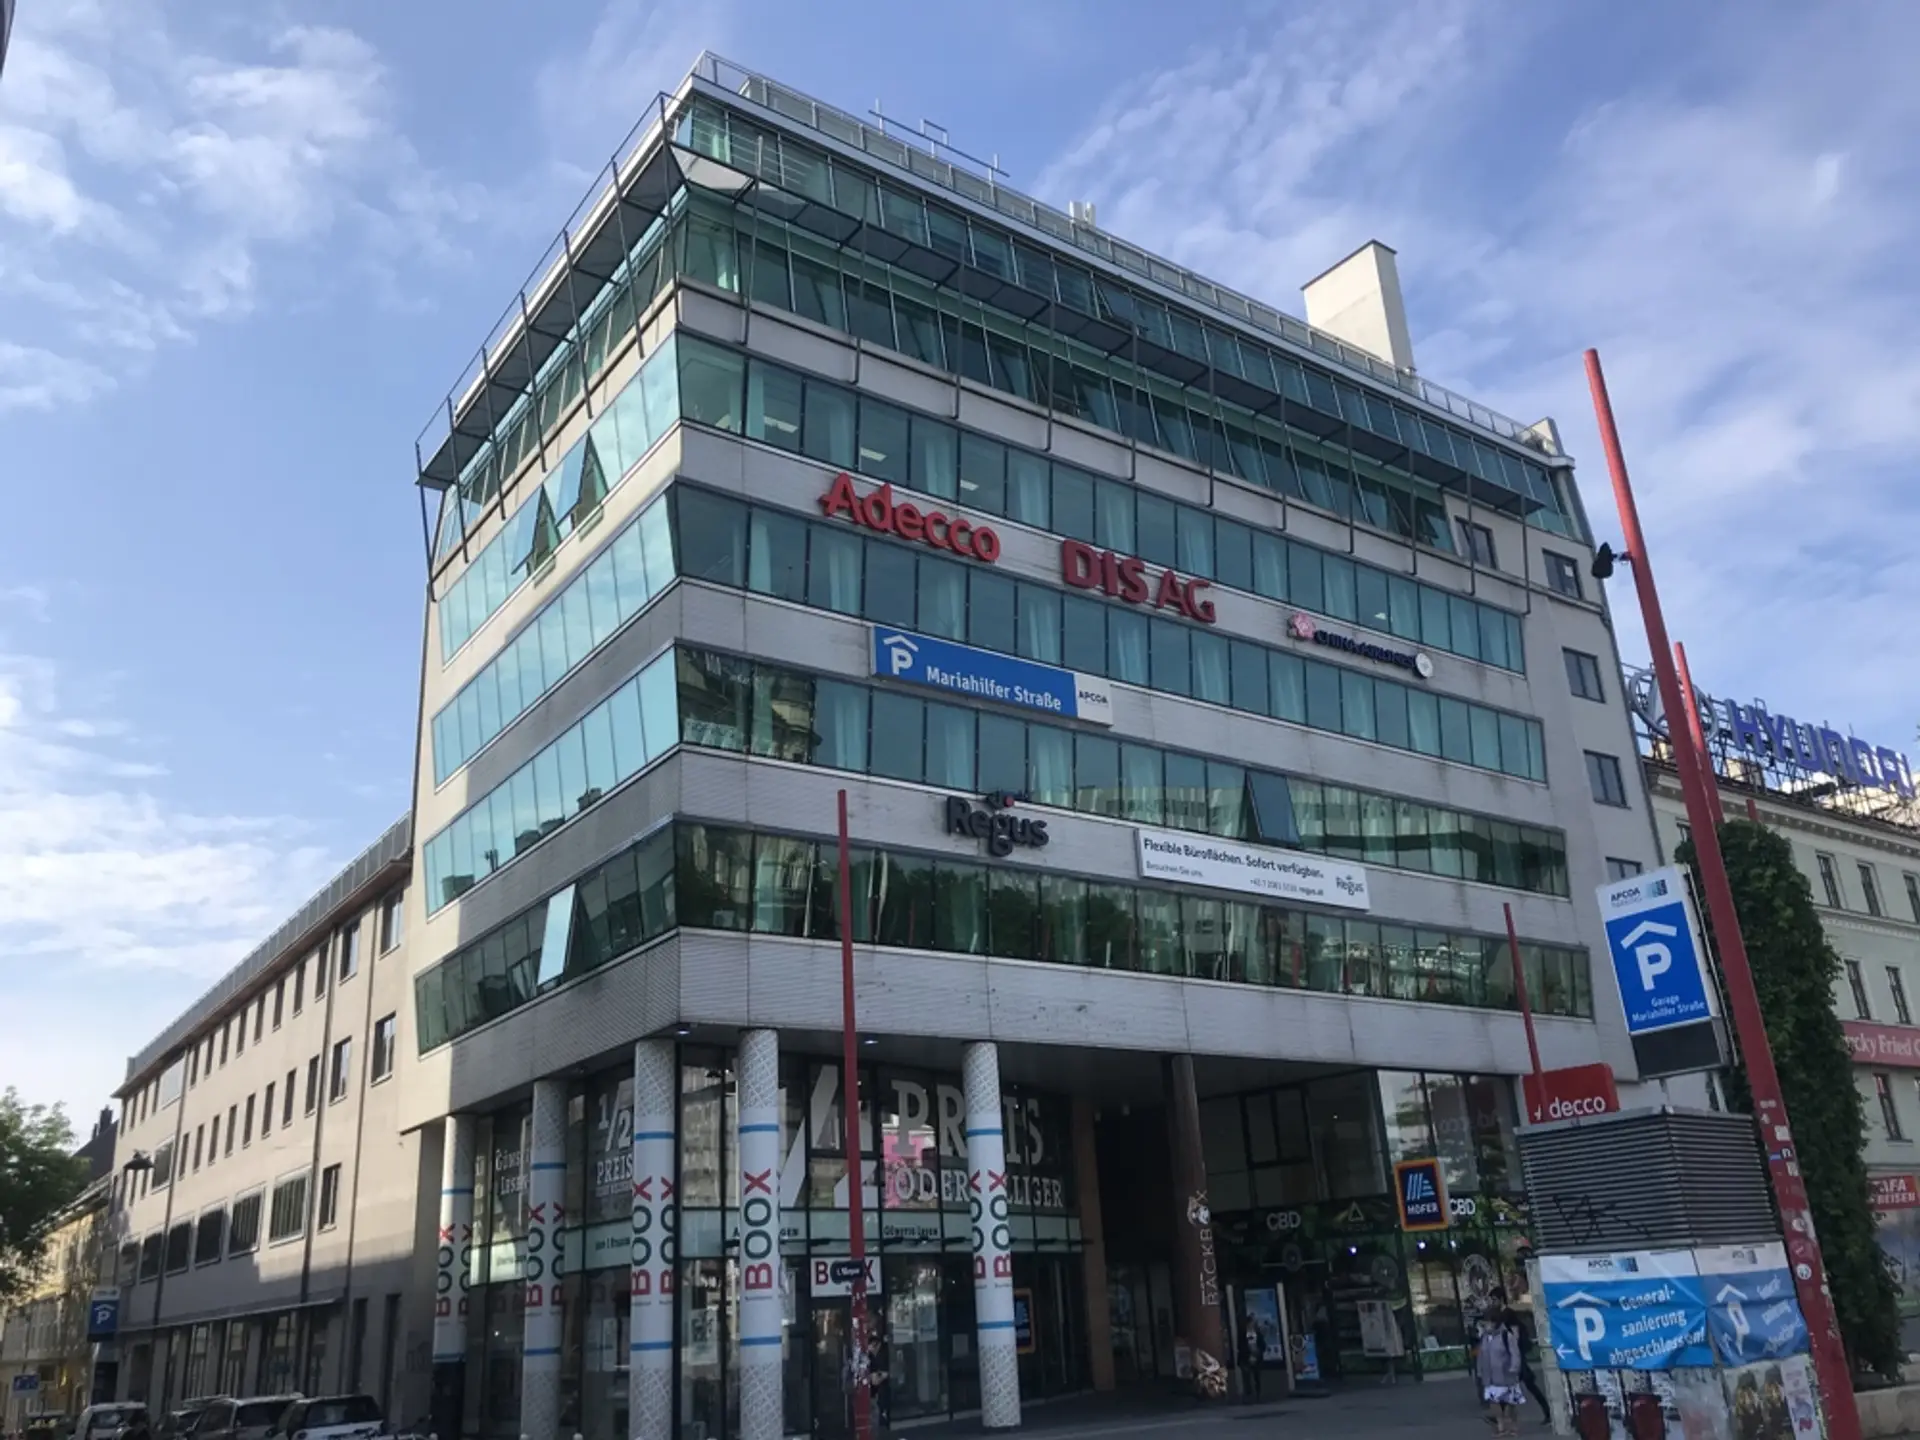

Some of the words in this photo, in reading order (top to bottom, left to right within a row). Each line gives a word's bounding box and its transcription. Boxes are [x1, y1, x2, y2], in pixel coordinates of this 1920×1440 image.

[819, 472, 1000, 562] Adecco
[1063, 540, 1149, 603] DIS
[1156, 570, 1216, 624] AG
[926, 665, 1010, 700] Mariahilfer
[1014, 686, 1062, 711] Straße
[1724, 698, 1916, 798] HYUNDAI
[947, 796, 1050, 857] Regus
[1144, 838, 1182, 856] Flexible
[1246, 854, 1277, 871] Sofort
[1336, 876, 1364, 896] Regus
[1611, 886, 1641, 902] APCOA
[1651, 994, 1680, 1008] Garage
[1877, 1034, 1912, 1057] Fried
[891, 1079, 1044, 1166] PRIS
[597, 1154, 633, 1185] PREIS
[896, 1167, 970, 1204] ODER
[1266, 1211, 1301, 1231] CBD
[1407, 1202, 1439, 1215] HOFER
[1450, 1198, 1477, 1215] CBD
[743, 1168, 773, 1290] BOOX
[1618, 1284, 1676, 1311] General-
[1621, 1309, 1688, 1338] sanierung
